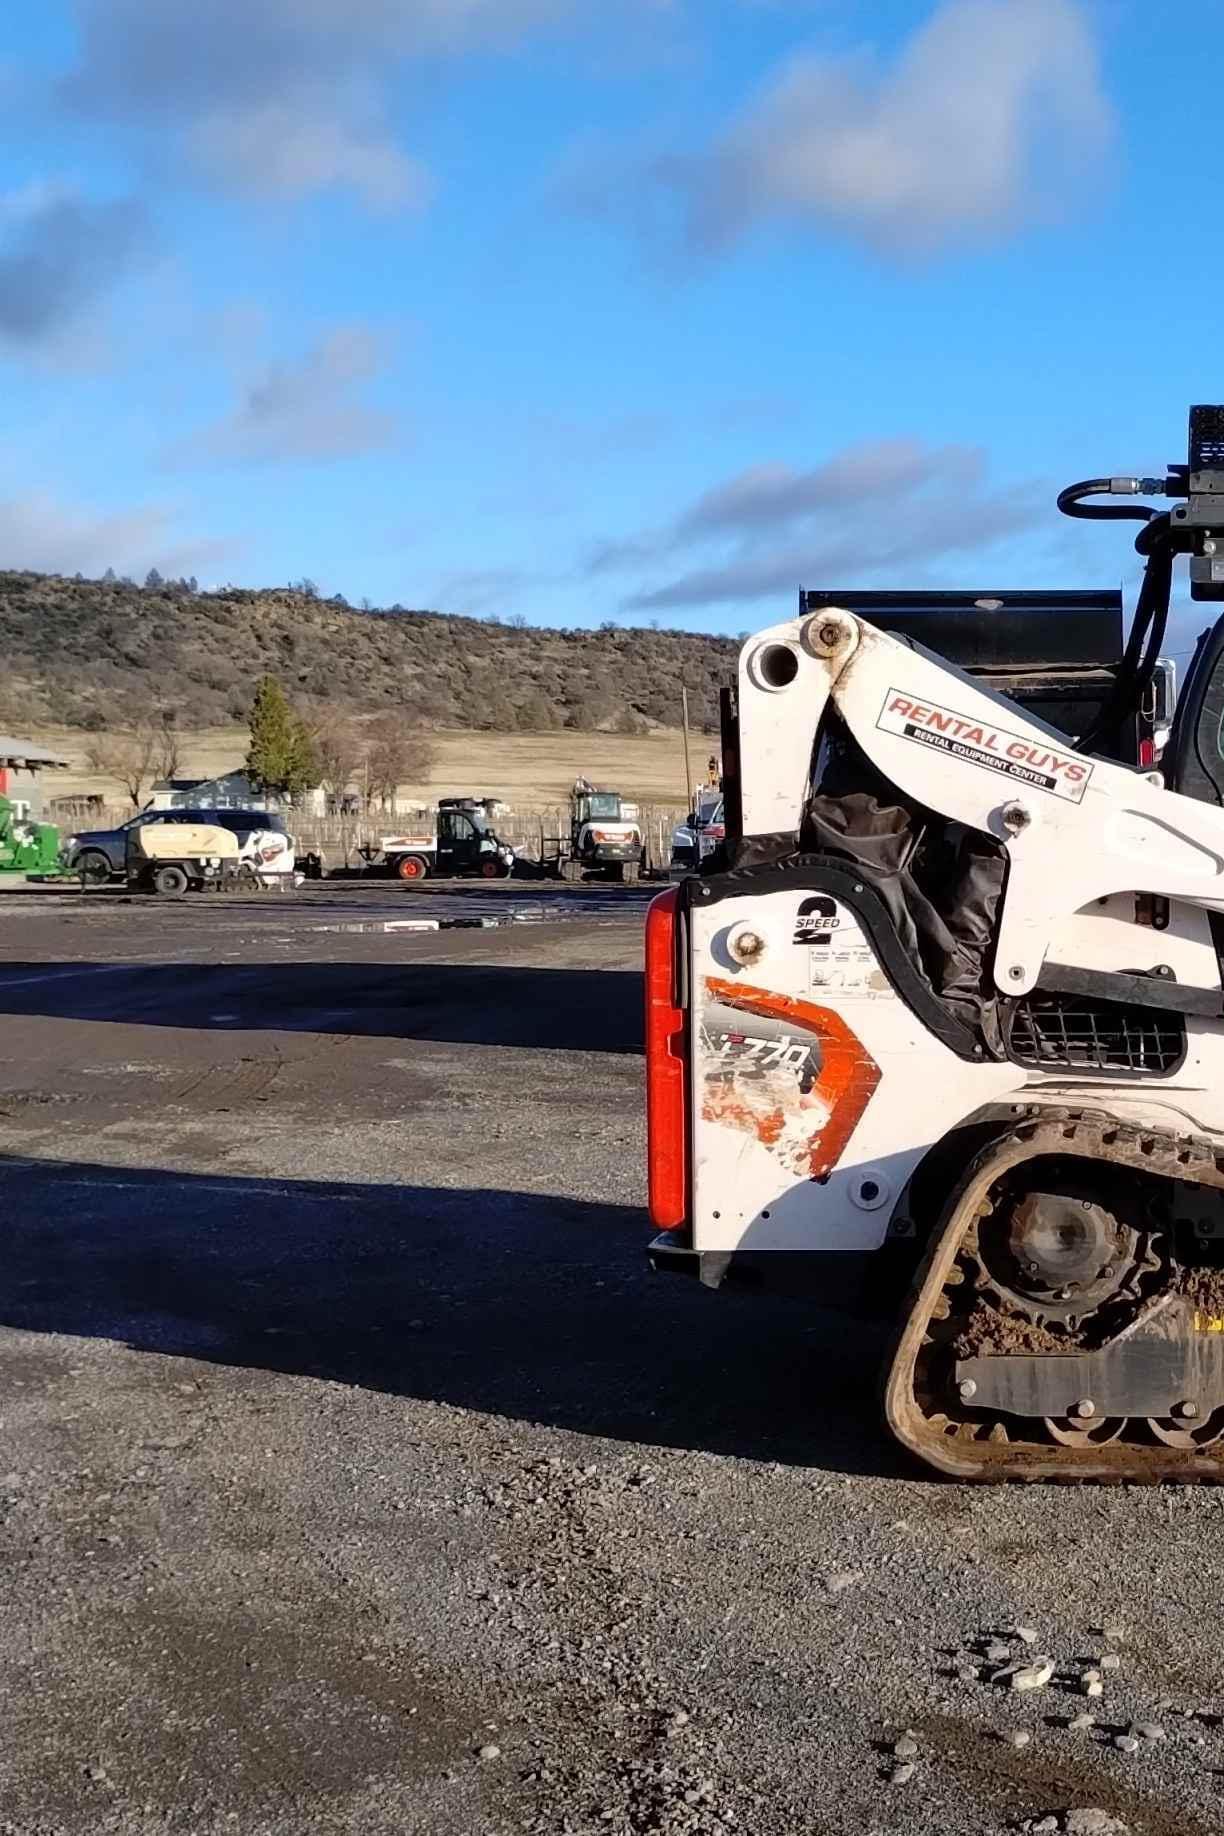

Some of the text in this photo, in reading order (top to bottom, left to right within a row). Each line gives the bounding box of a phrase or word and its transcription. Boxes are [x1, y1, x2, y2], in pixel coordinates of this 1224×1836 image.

[888, 697, 1087, 781] RENTAL GUYS
[913, 728, 1048, 786] RENTAL EQUIPMENT CENTER
[795, 918, 840, 929] SPEED
